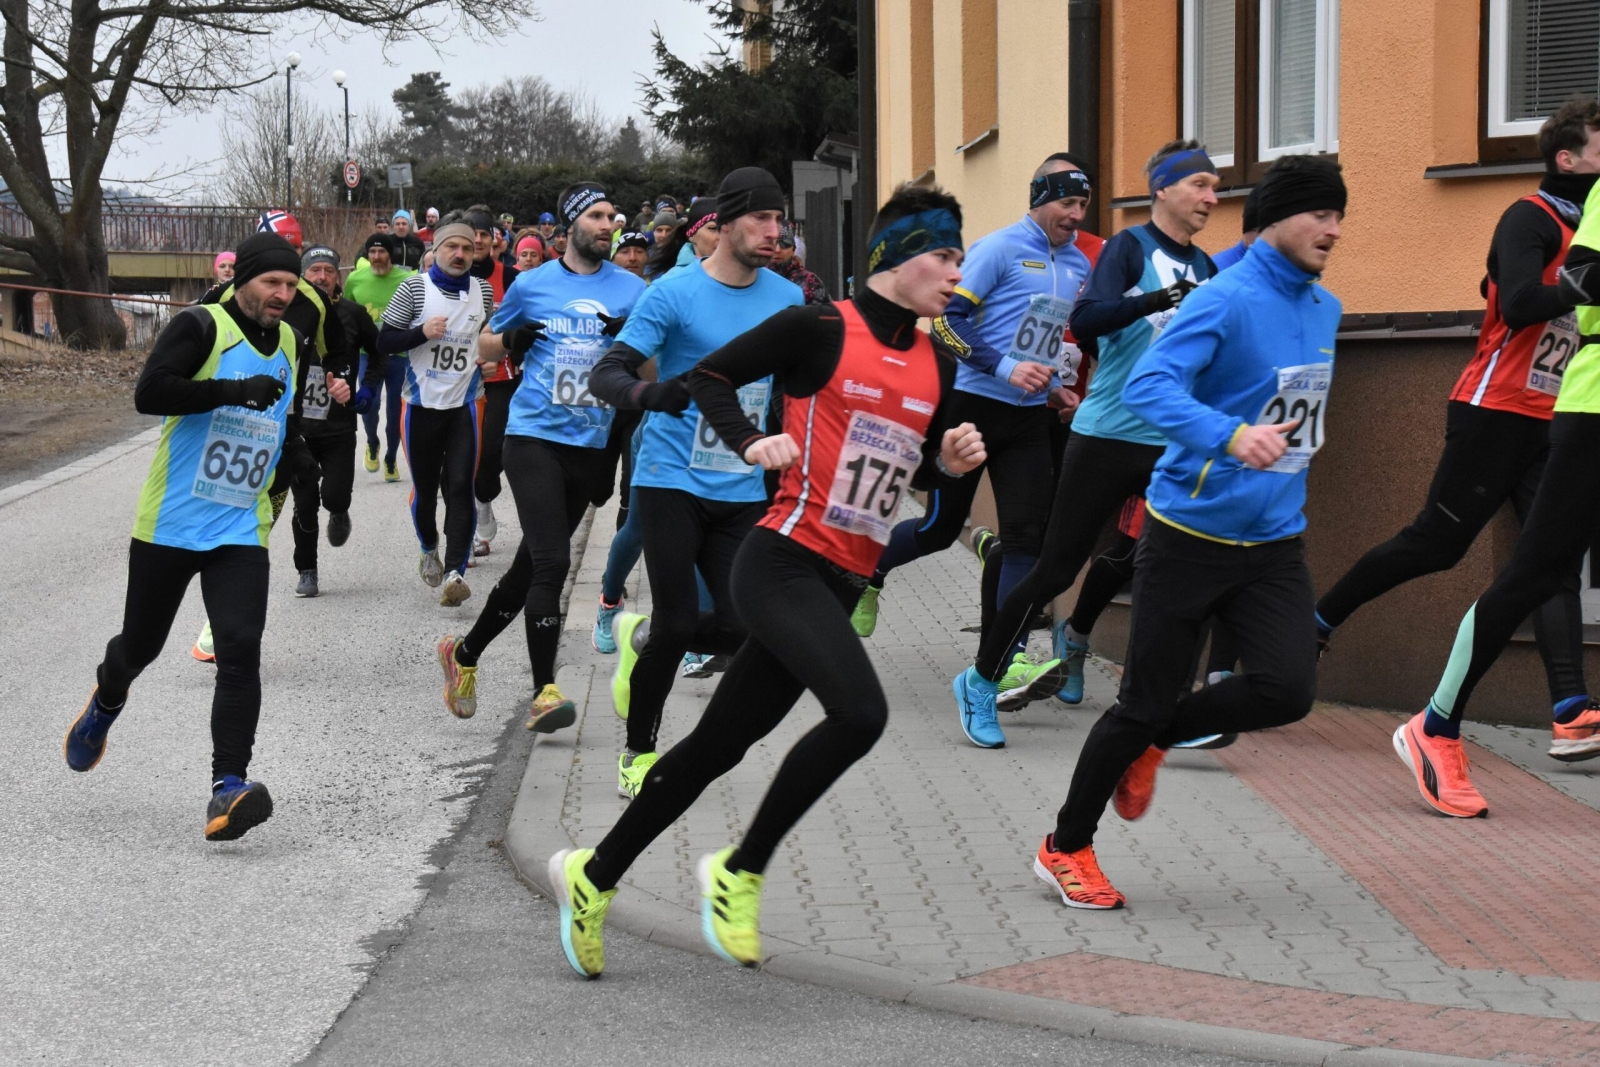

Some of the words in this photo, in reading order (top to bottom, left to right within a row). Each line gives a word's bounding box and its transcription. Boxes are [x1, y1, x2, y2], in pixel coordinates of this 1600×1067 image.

[540, 318, 607, 336] RUNLABE
[1016, 316, 1063, 359] 676
[431, 344, 468, 372] 195
[556, 356, 594, 366] BĚŽECKÁ
[557, 348, 583, 356] ZIMNÍ
[556, 369, 609, 407] 62
[215, 412, 245, 426] ZIMNÍ
[854, 417, 890, 436] ZIMNÍ
[1265, 397, 1322, 448] 221
[211, 423, 253, 440] BĚŽECKÁ
[257, 433, 276, 444] LIGA
[850, 430, 897, 454] BĚŽECKÁ
[203, 440, 270, 489] 658
[846, 454, 907, 518] 175
